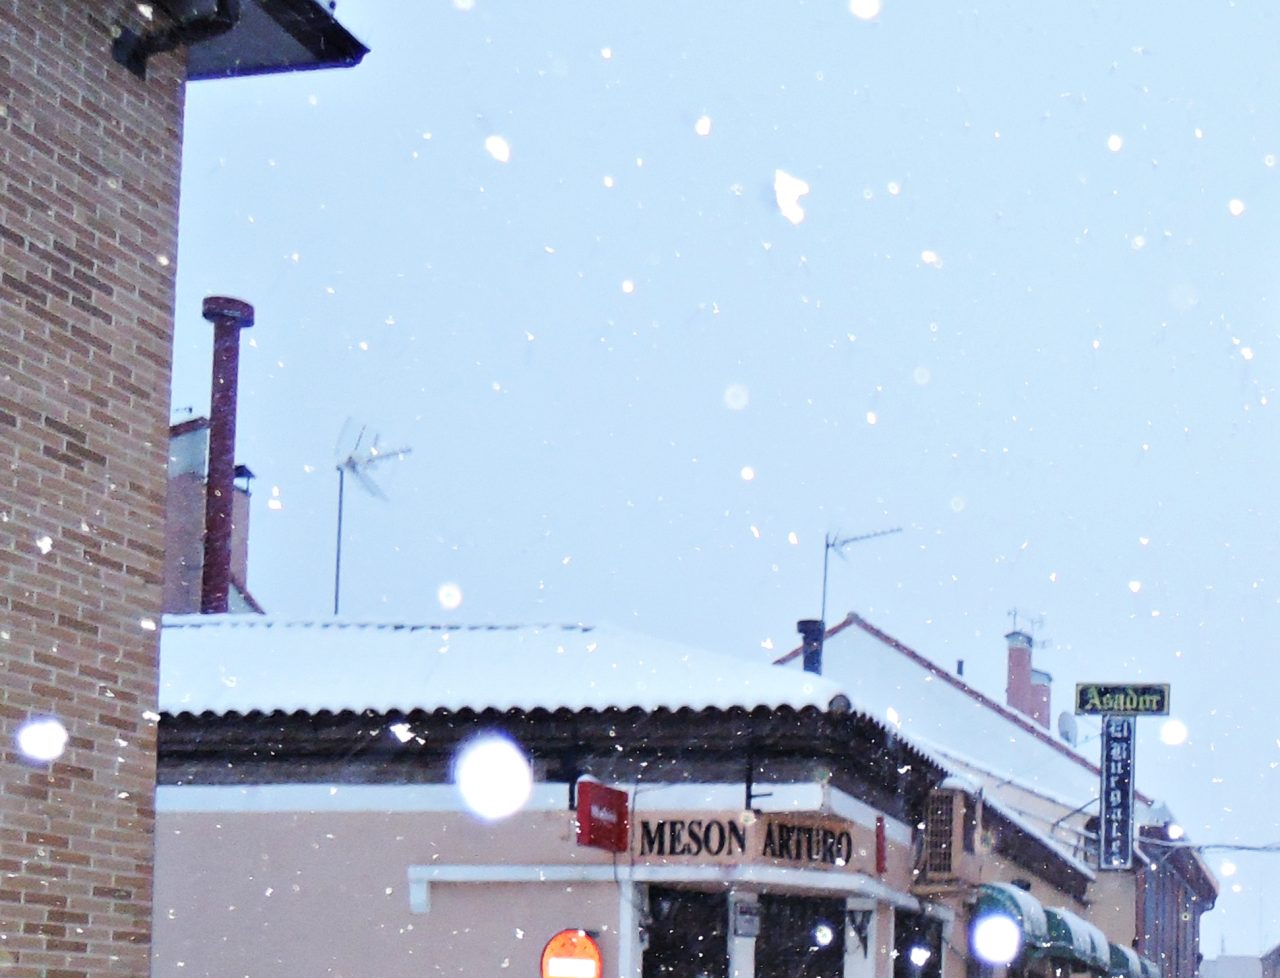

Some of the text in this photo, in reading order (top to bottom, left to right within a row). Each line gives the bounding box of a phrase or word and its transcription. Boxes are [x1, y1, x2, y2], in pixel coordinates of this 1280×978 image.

[1085, 686, 1161, 711] Asador
[640, 819, 853, 866] MESON ARTURO
